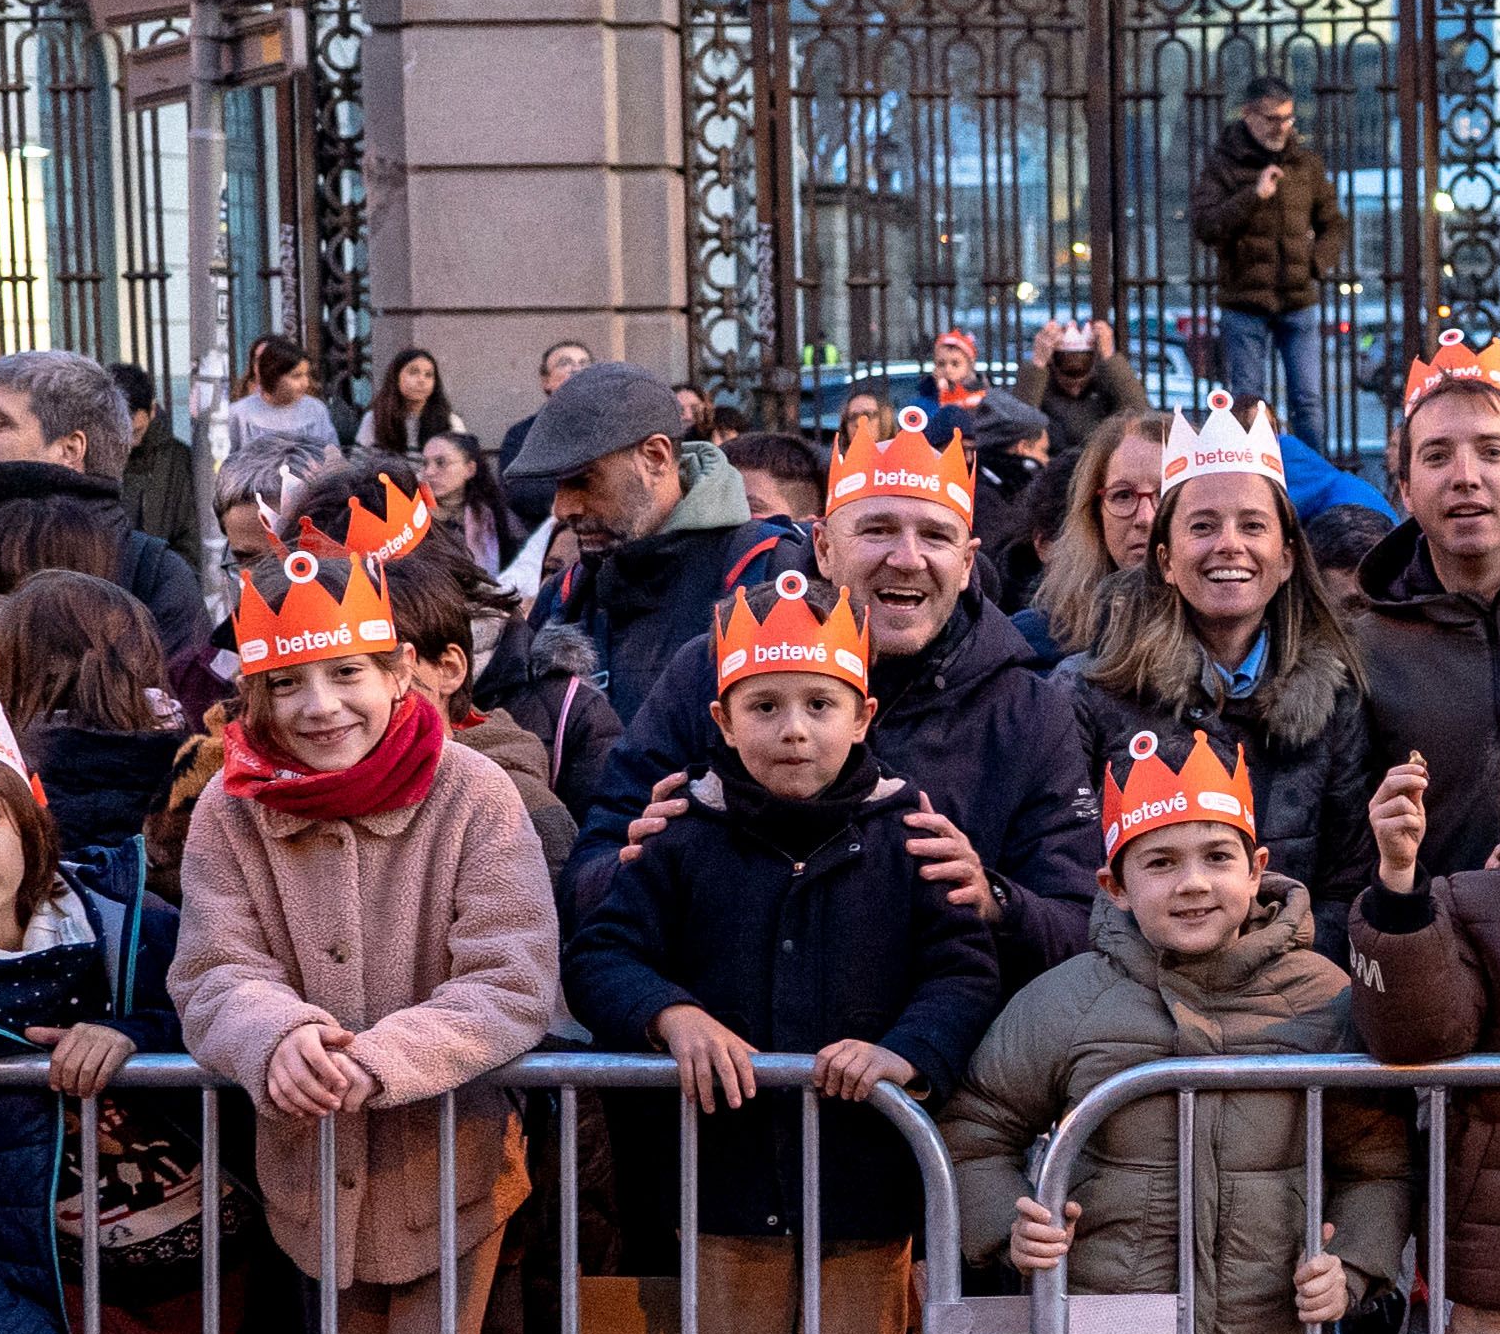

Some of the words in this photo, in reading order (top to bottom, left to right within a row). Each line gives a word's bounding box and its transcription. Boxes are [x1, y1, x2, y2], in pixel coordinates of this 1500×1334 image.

[1193, 448, 1253, 468] betevé
[873, 468, 940, 492] betevé
[275, 624, 352, 656] betevé
[754, 641, 827, 663] betevé
[1122, 792, 1188, 831] betevé
